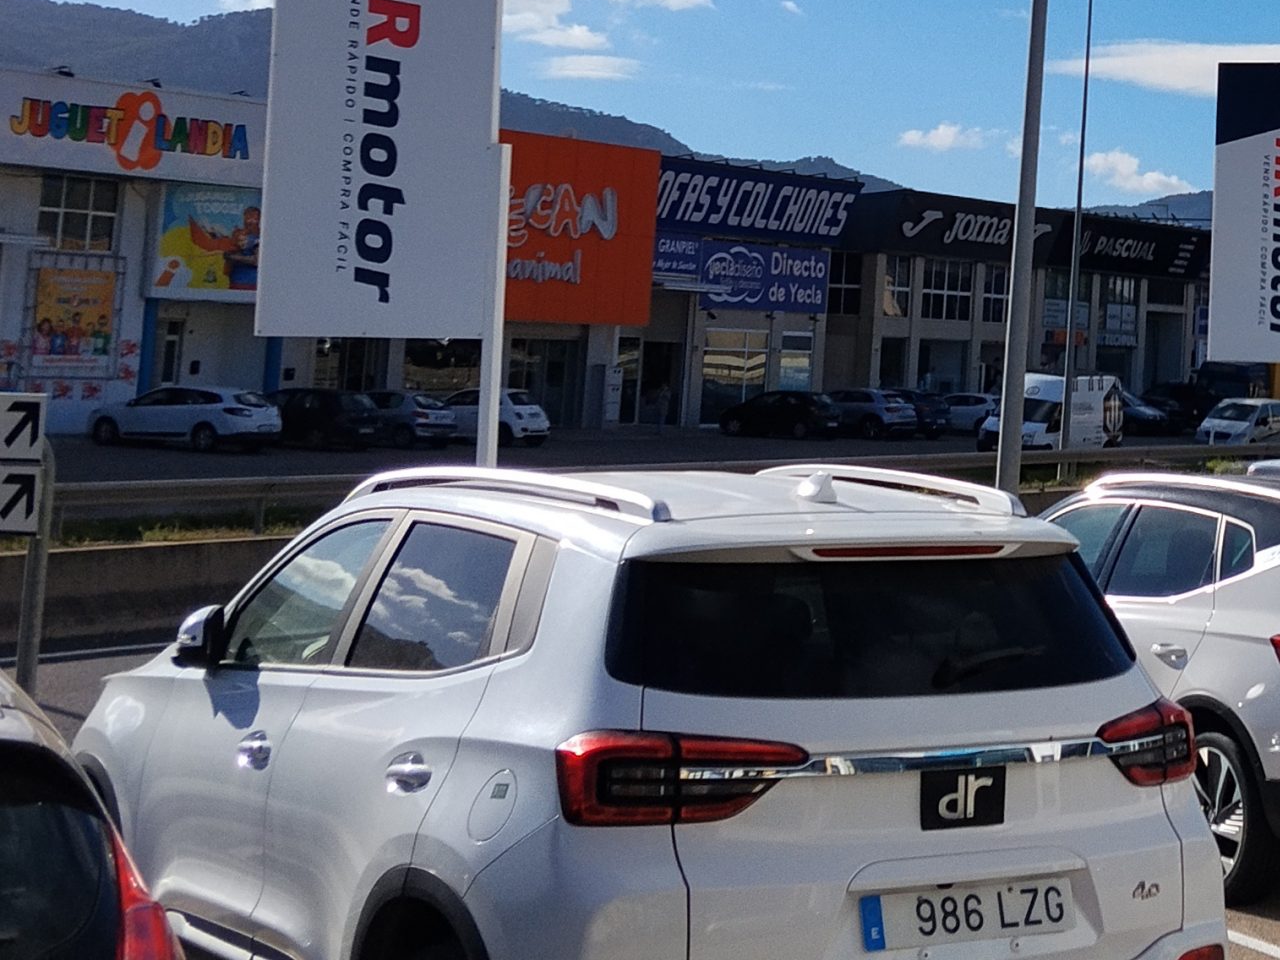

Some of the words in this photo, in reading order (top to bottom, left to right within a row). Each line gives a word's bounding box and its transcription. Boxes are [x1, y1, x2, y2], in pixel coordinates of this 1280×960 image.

[340, 133, 355, 210] COMPRA
[1261, 153, 1271, 189] VENDE
[657, 170, 720, 223] OFAS
[770, 251, 826, 279] Directo
[1094, 236, 1155, 261] PASCUAL
[1259, 246, 1268, 291] COMPRA
[768, 282, 786, 303] de
[789, 284, 822, 305] Yecla
[938, 772, 994, 821] dr
[916, 893, 985, 937] 986
[998, 886, 1065, 930] LZG
